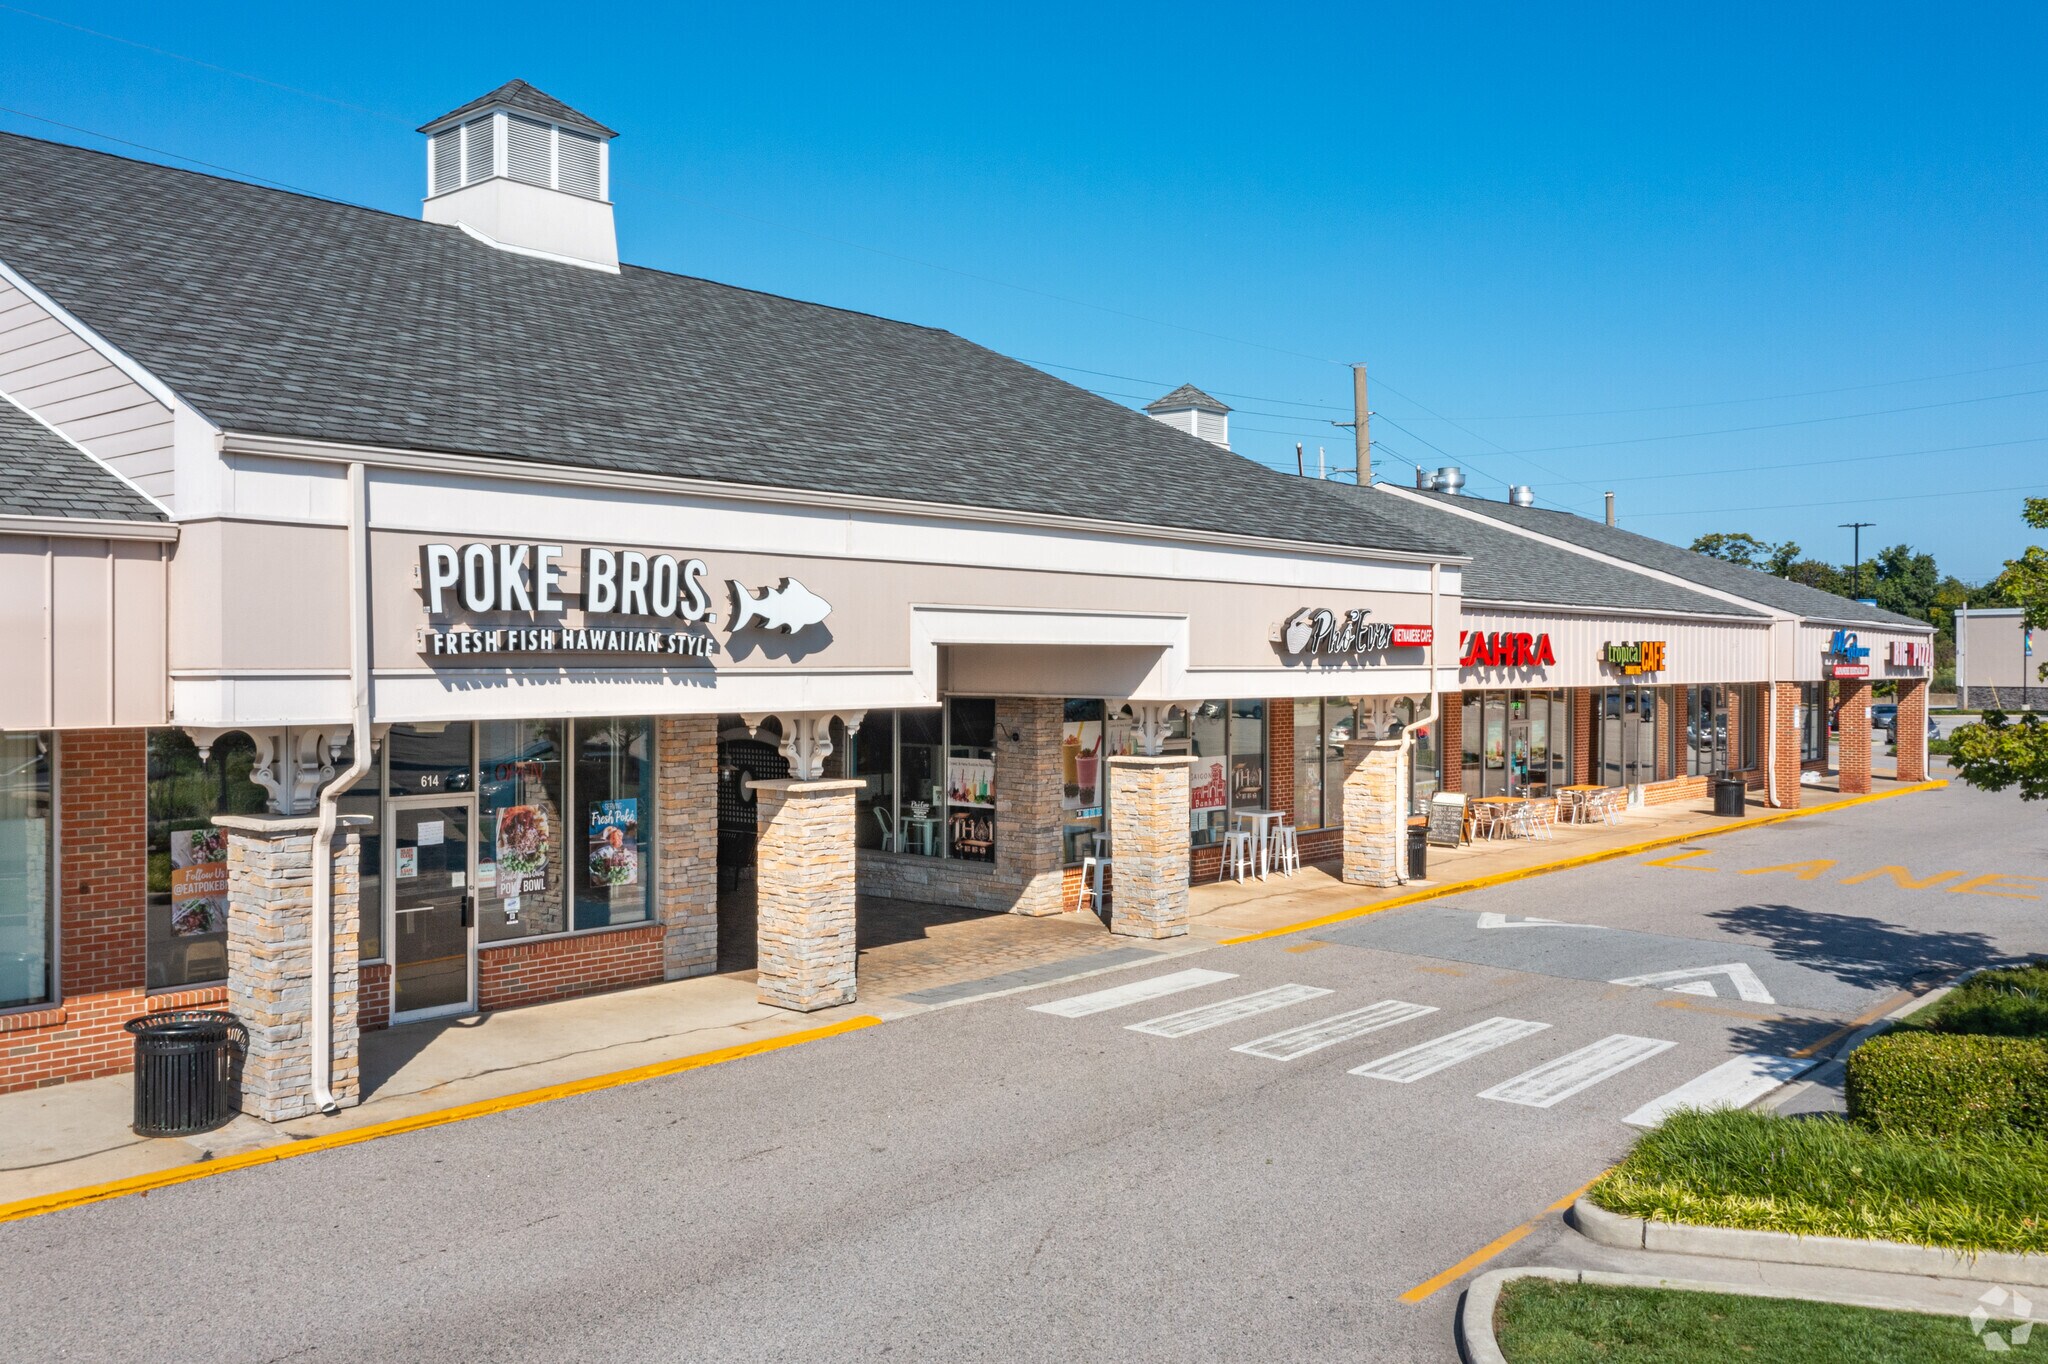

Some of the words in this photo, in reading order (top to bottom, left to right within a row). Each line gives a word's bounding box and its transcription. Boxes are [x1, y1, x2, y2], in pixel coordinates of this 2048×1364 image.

[427, 543, 563, 613] POKE
[588, 548, 717, 624] BROS.
[434, 631, 498, 655] FRESH
[508, 630, 553, 651] FISH
[562, 629, 659, 653] HAWAIIAN
[667, 634, 713, 657] STYLE
[1394, 628, 1421, 642] VIETNAMESE
[1421, 629, 1432, 642] CAFE
[1608, 641, 1642, 666] tropical
[1642, 641, 1666, 671] CAFE
[1893, 641, 1908, 666] BIG
[1913, 642, 1934, 667] PIZZA
[421, 775, 439, 787] 614
[495, 762, 544, 782] OPEN
[591, 810, 614, 826] Fresh
[185, 869, 213, 882] Follow
[532, 869, 545, 878] Own
[1641, 849, 2048, 899] LANE
[523, 878, 546, 892] BOWL
